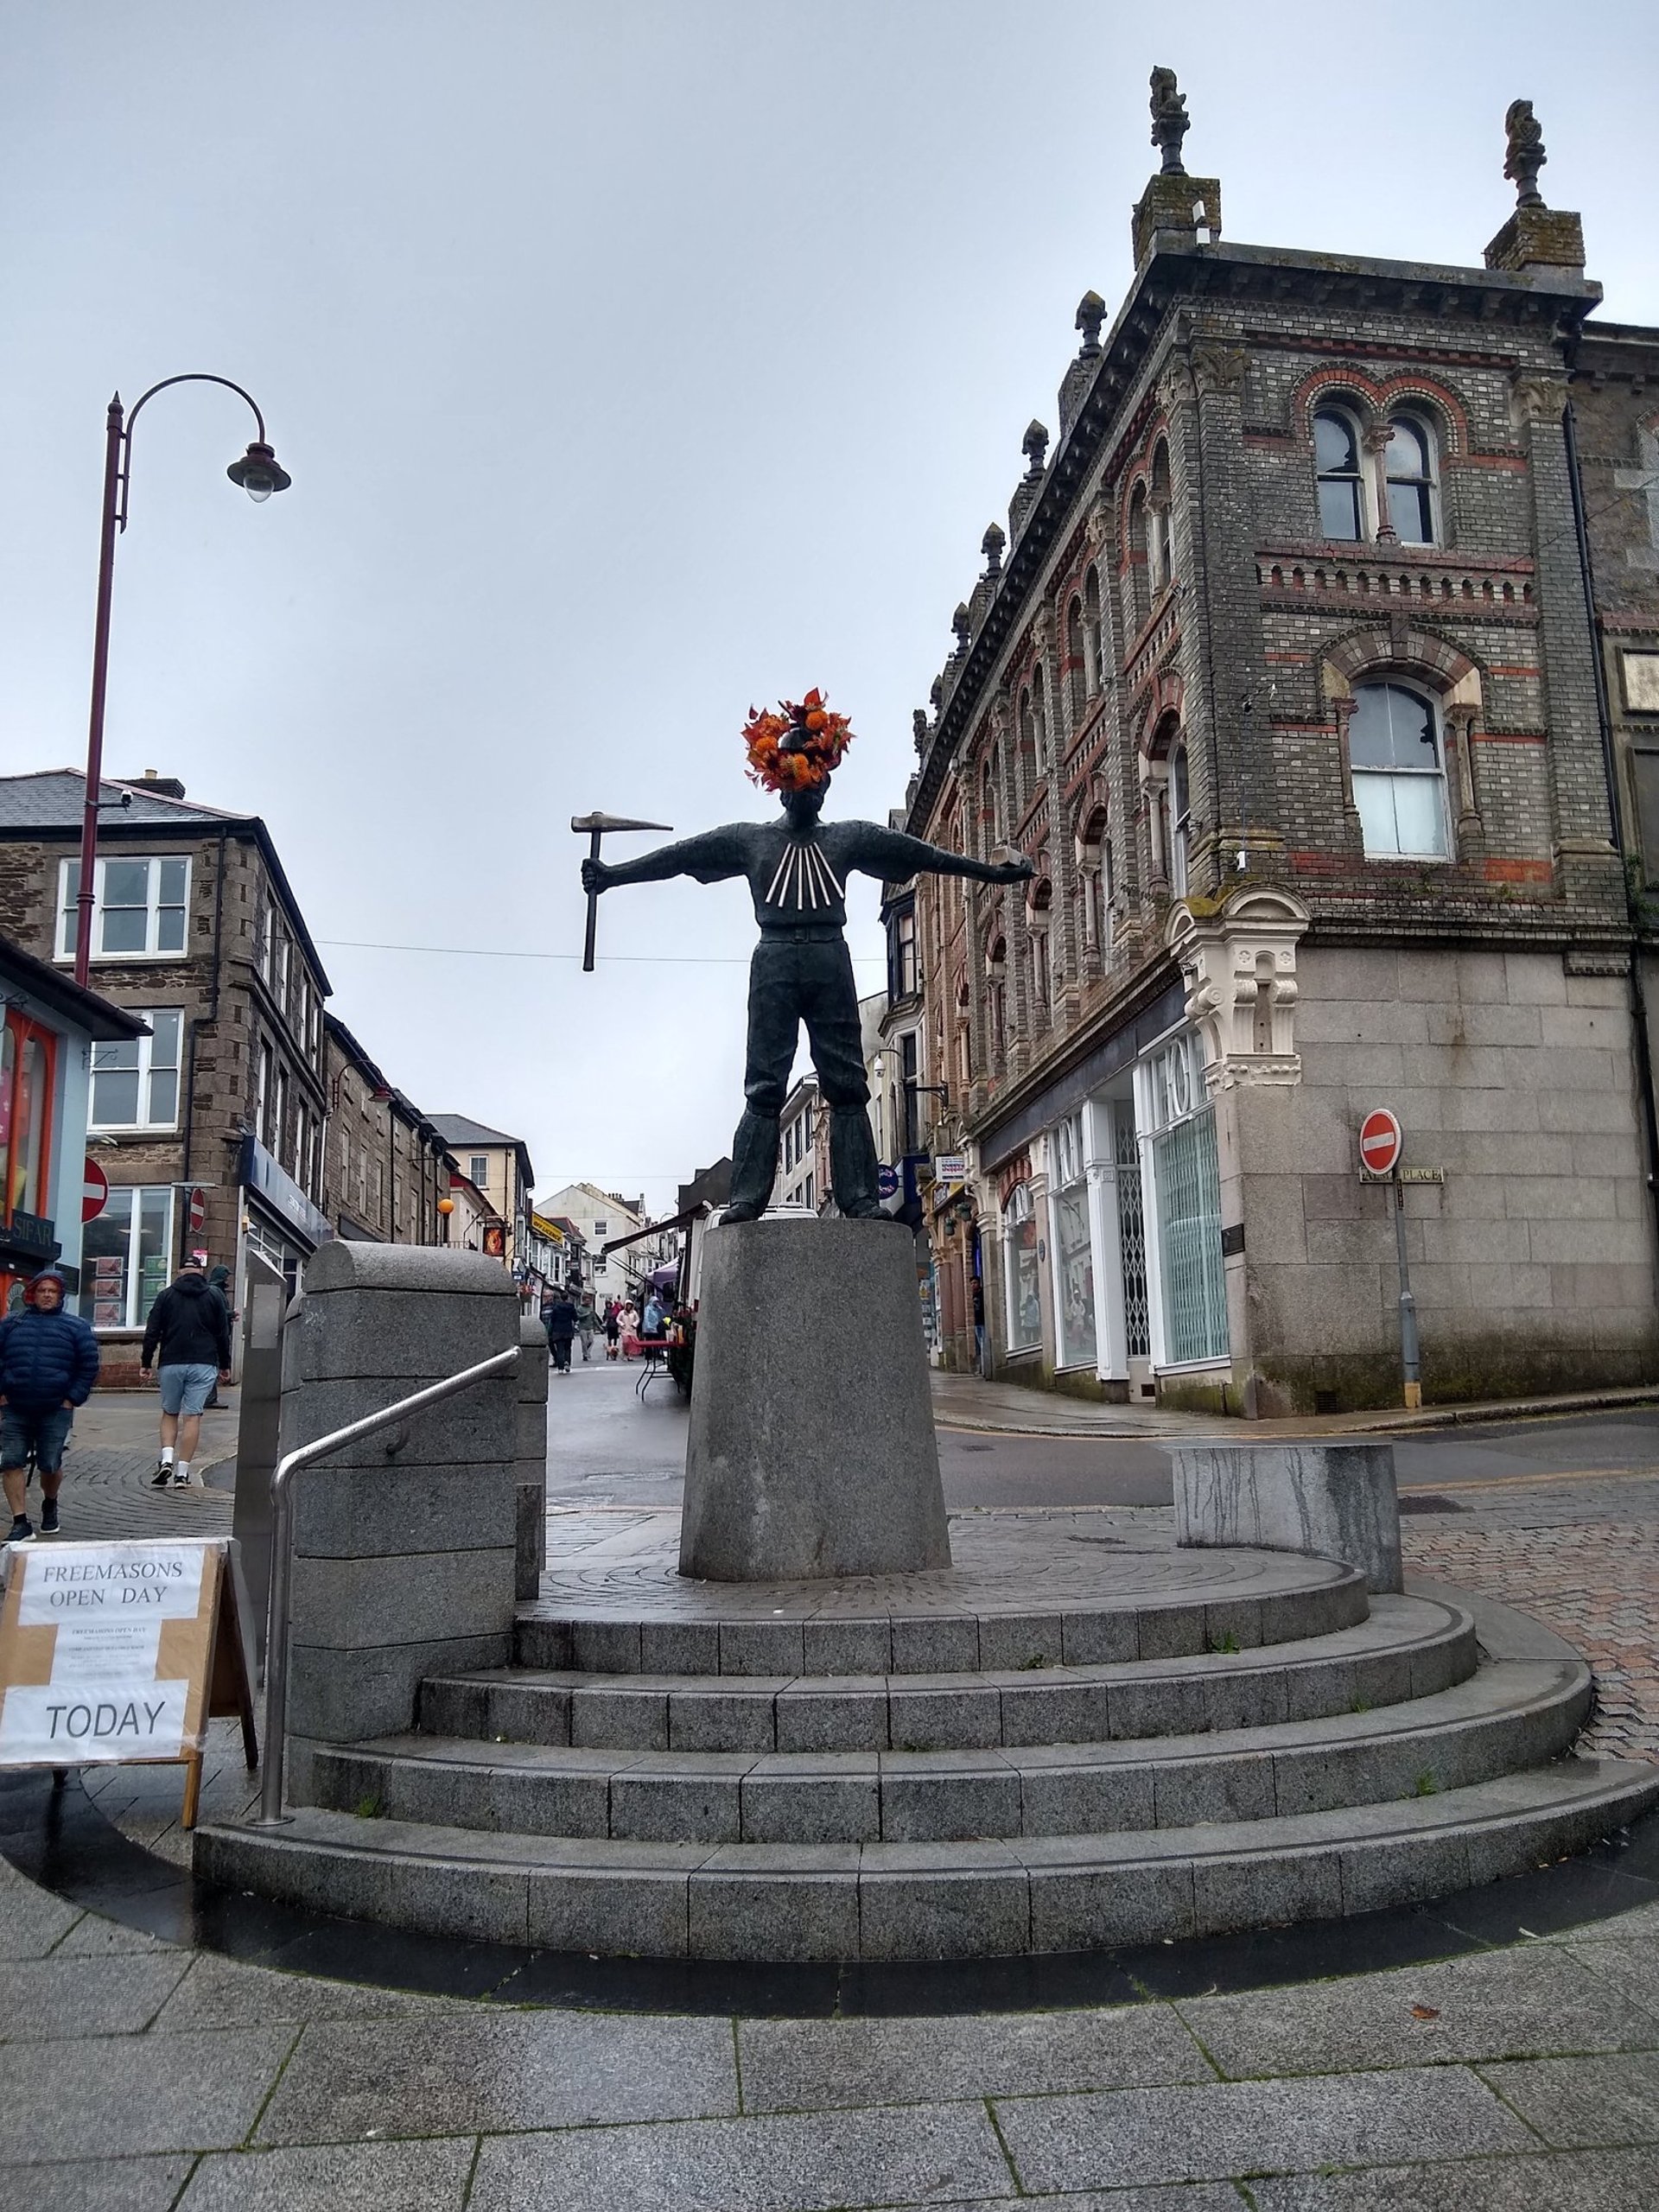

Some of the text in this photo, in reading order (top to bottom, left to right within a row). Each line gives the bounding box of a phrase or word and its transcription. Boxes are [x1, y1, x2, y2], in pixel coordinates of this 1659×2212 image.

[1402, 1169, 1439, 1181] PLACE
[14, 1217, 52, 1247] SIFAR
[43, 1562, 183, 1582] FREEMASONS
[50, 1586, 168, 1607] OPEN DAY
[46, 1701, 166, 1738] TODAY
